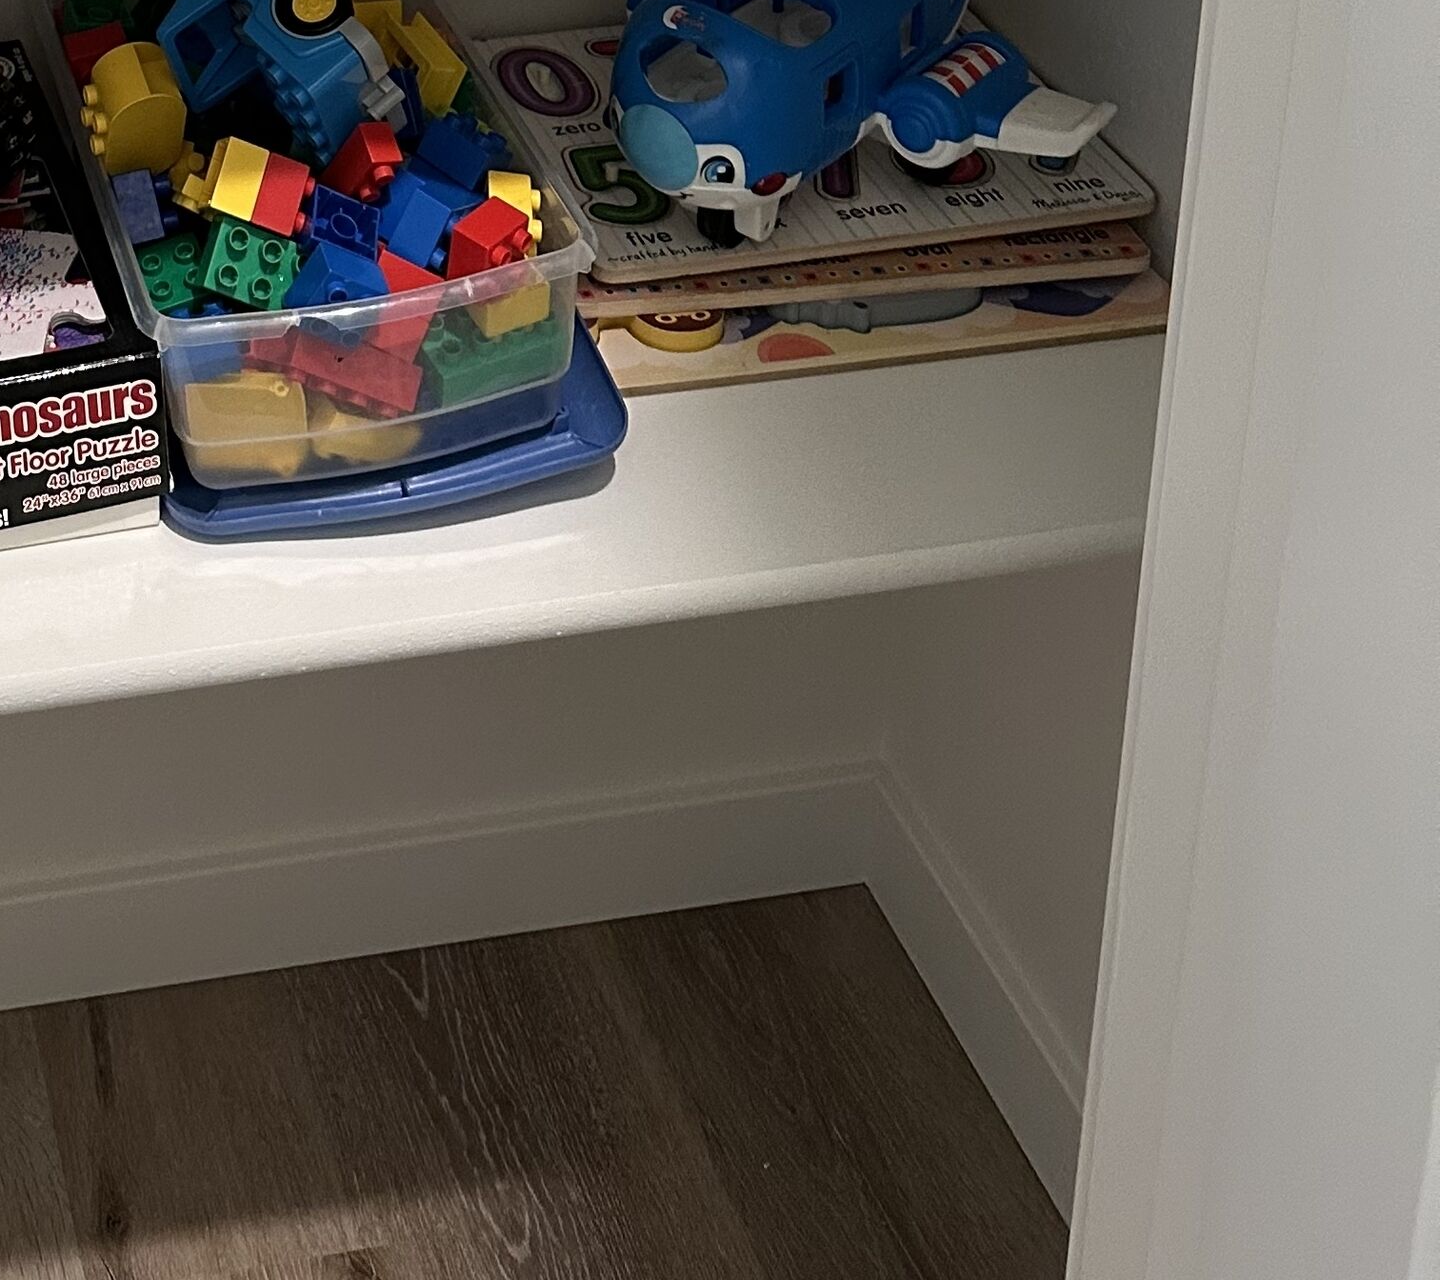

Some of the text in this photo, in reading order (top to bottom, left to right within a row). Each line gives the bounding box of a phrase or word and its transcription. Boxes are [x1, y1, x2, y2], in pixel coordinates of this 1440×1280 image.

[552, 120, 601, 137] zero
[1054, 176, 1106, 194] nine
[945, 188, 1005, 208] eight
[836, 201, 907, 222] seven
[625, 229, 673, 247] five
[671, 246, 687, 258] by
[9, 447, 71, 478] Floor
[74, 426, 159, 463] Puzzle
[47, 455, 160, 489] 48 large pieces
